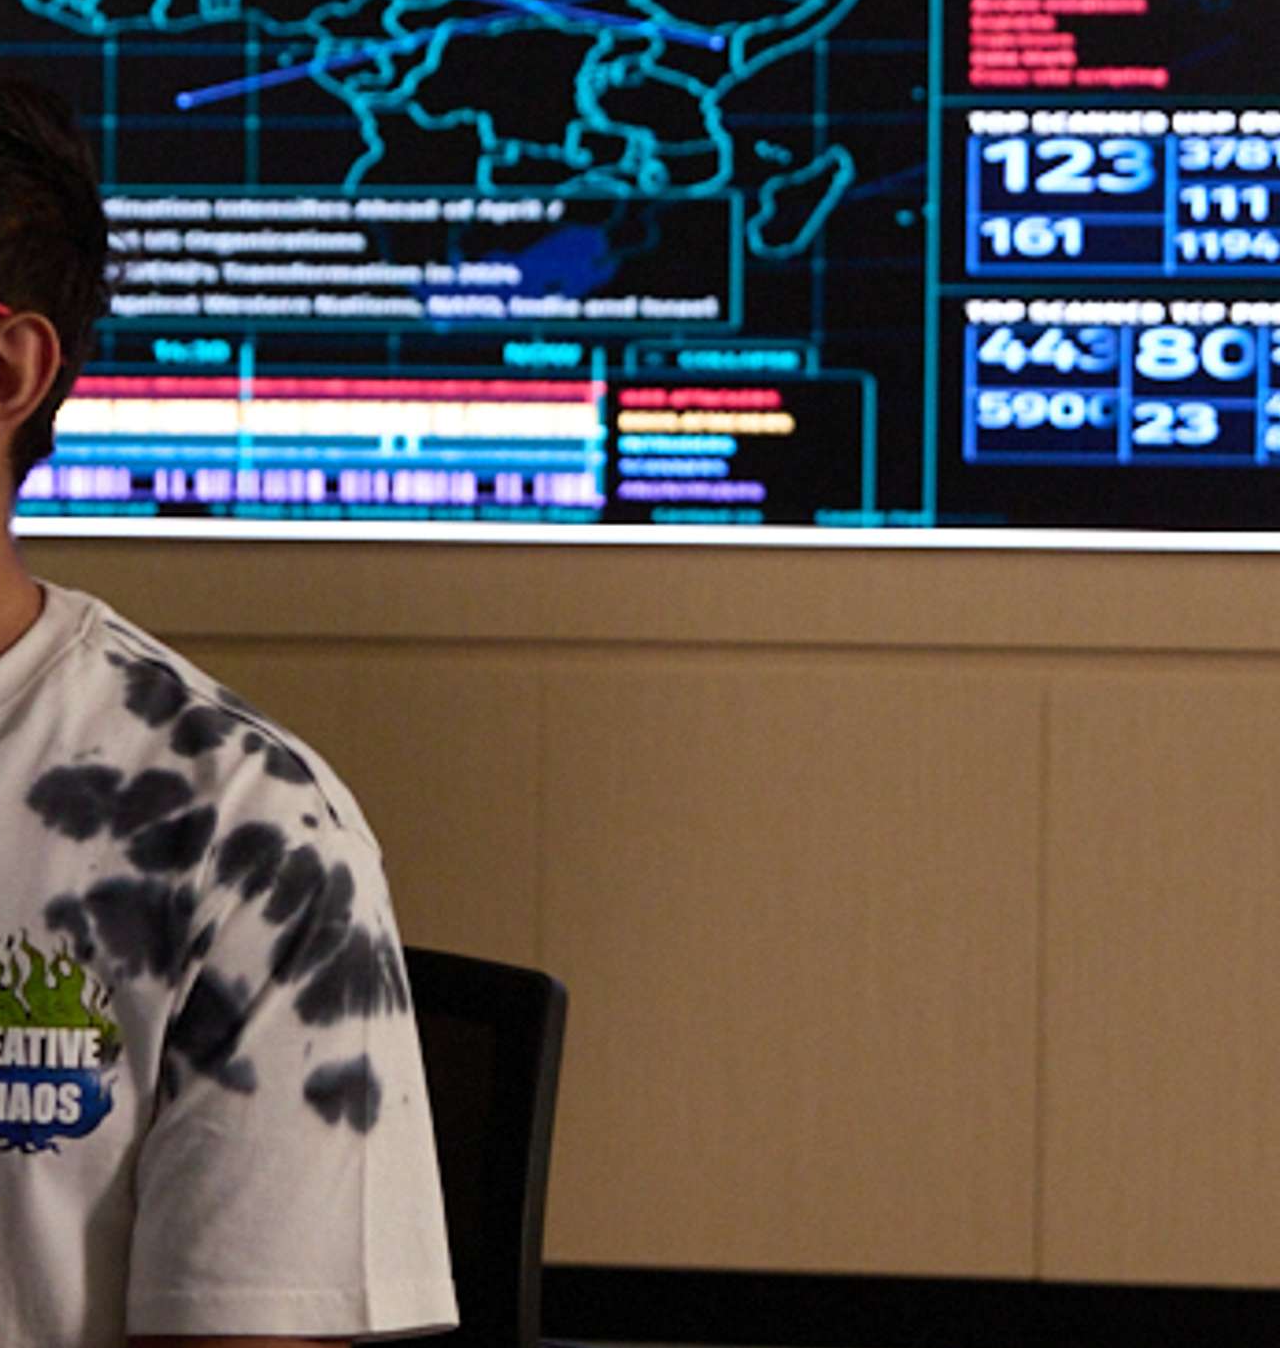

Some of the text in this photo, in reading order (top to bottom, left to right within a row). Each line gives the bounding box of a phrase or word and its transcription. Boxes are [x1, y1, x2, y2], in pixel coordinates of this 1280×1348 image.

[982, 138, 1157, 195] 123
[1179, 184, 1270, 222] 111
[980, 216, 1084, 257] 161
[978, 327, 1119, 374] 443
[1135, 326, 1257, 382] 80
[1132, 402, 1221, 446] 23
